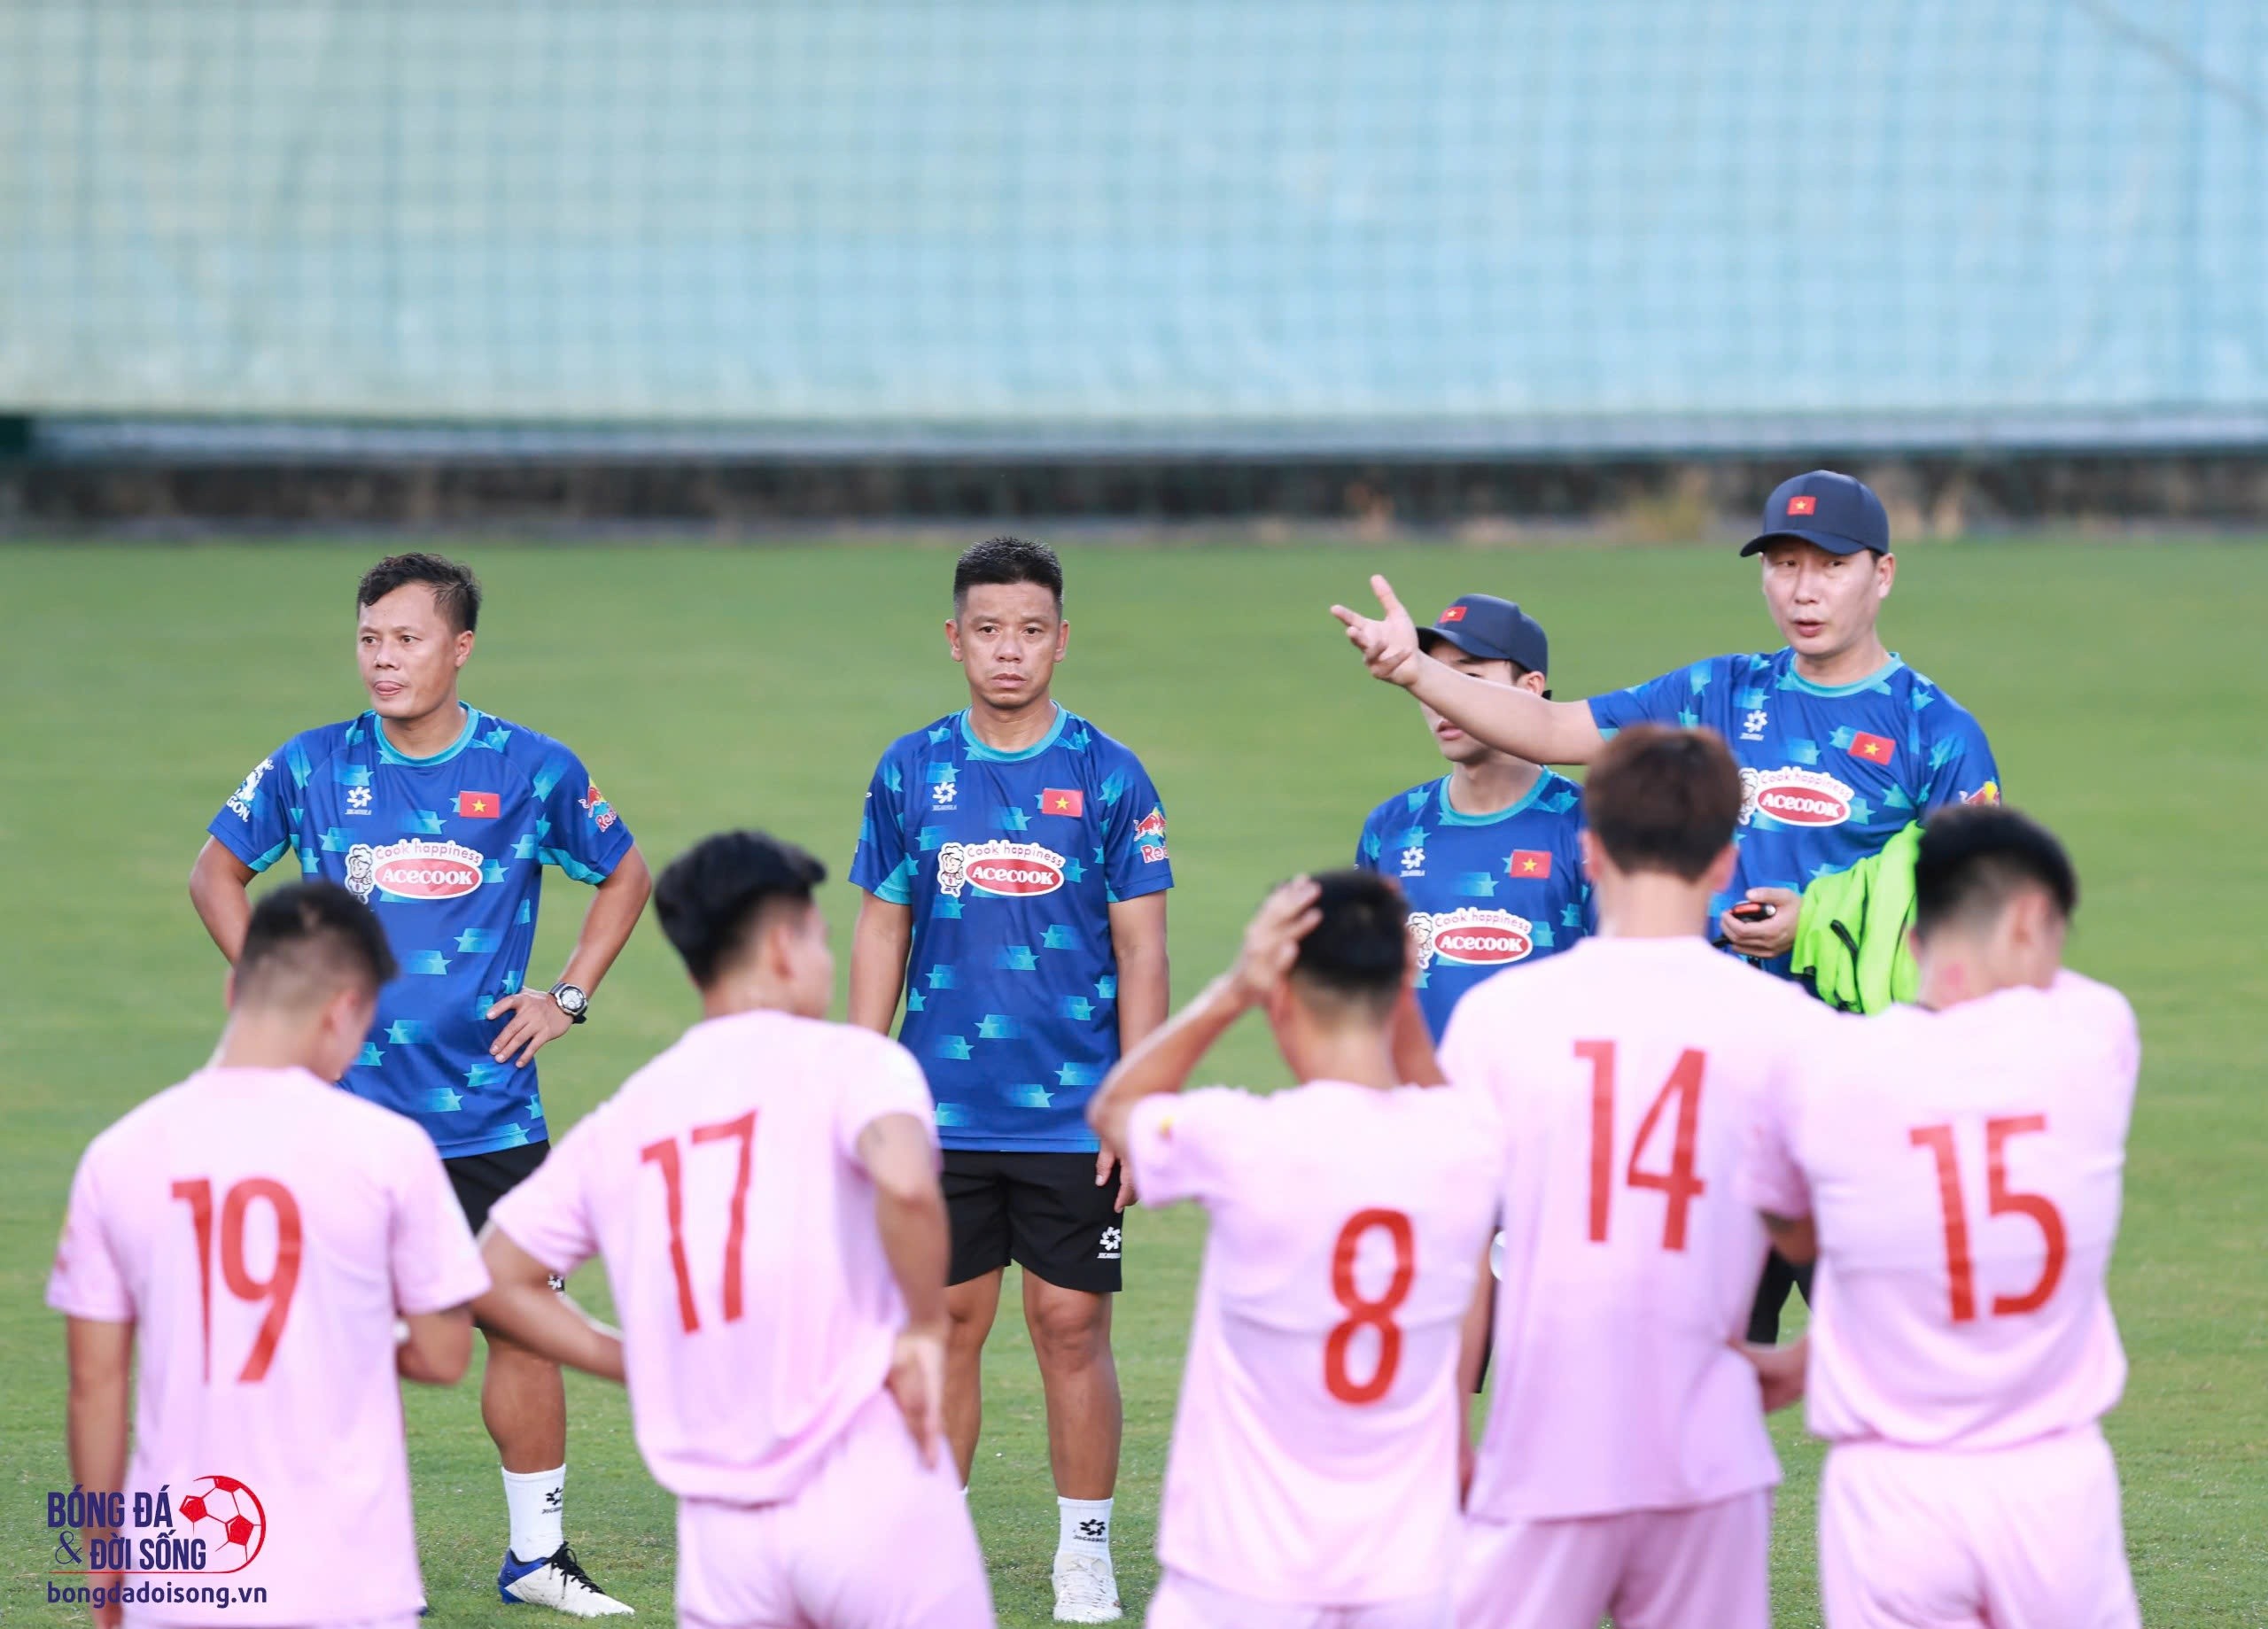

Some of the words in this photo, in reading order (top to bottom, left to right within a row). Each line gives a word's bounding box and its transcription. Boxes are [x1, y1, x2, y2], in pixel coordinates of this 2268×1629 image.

[376, 841, 408, 859] Cook
[415, 841, 480, 864] happiness
[967, 843, 999, 857] Cook
[1004, 842, 1062, 866] happiness
[1435, 911, 1467, 927] Cook
[1472, 911, 1529, 932] happiness
[641, 1108, 757, 1335] 17
[1573, 1040, 1707, 1252] 14
[1909, 1113, 2067, 1323] 15
[171, 1177, 302, 1385] 19
[1323, 1207, 1414, 1405] 8
